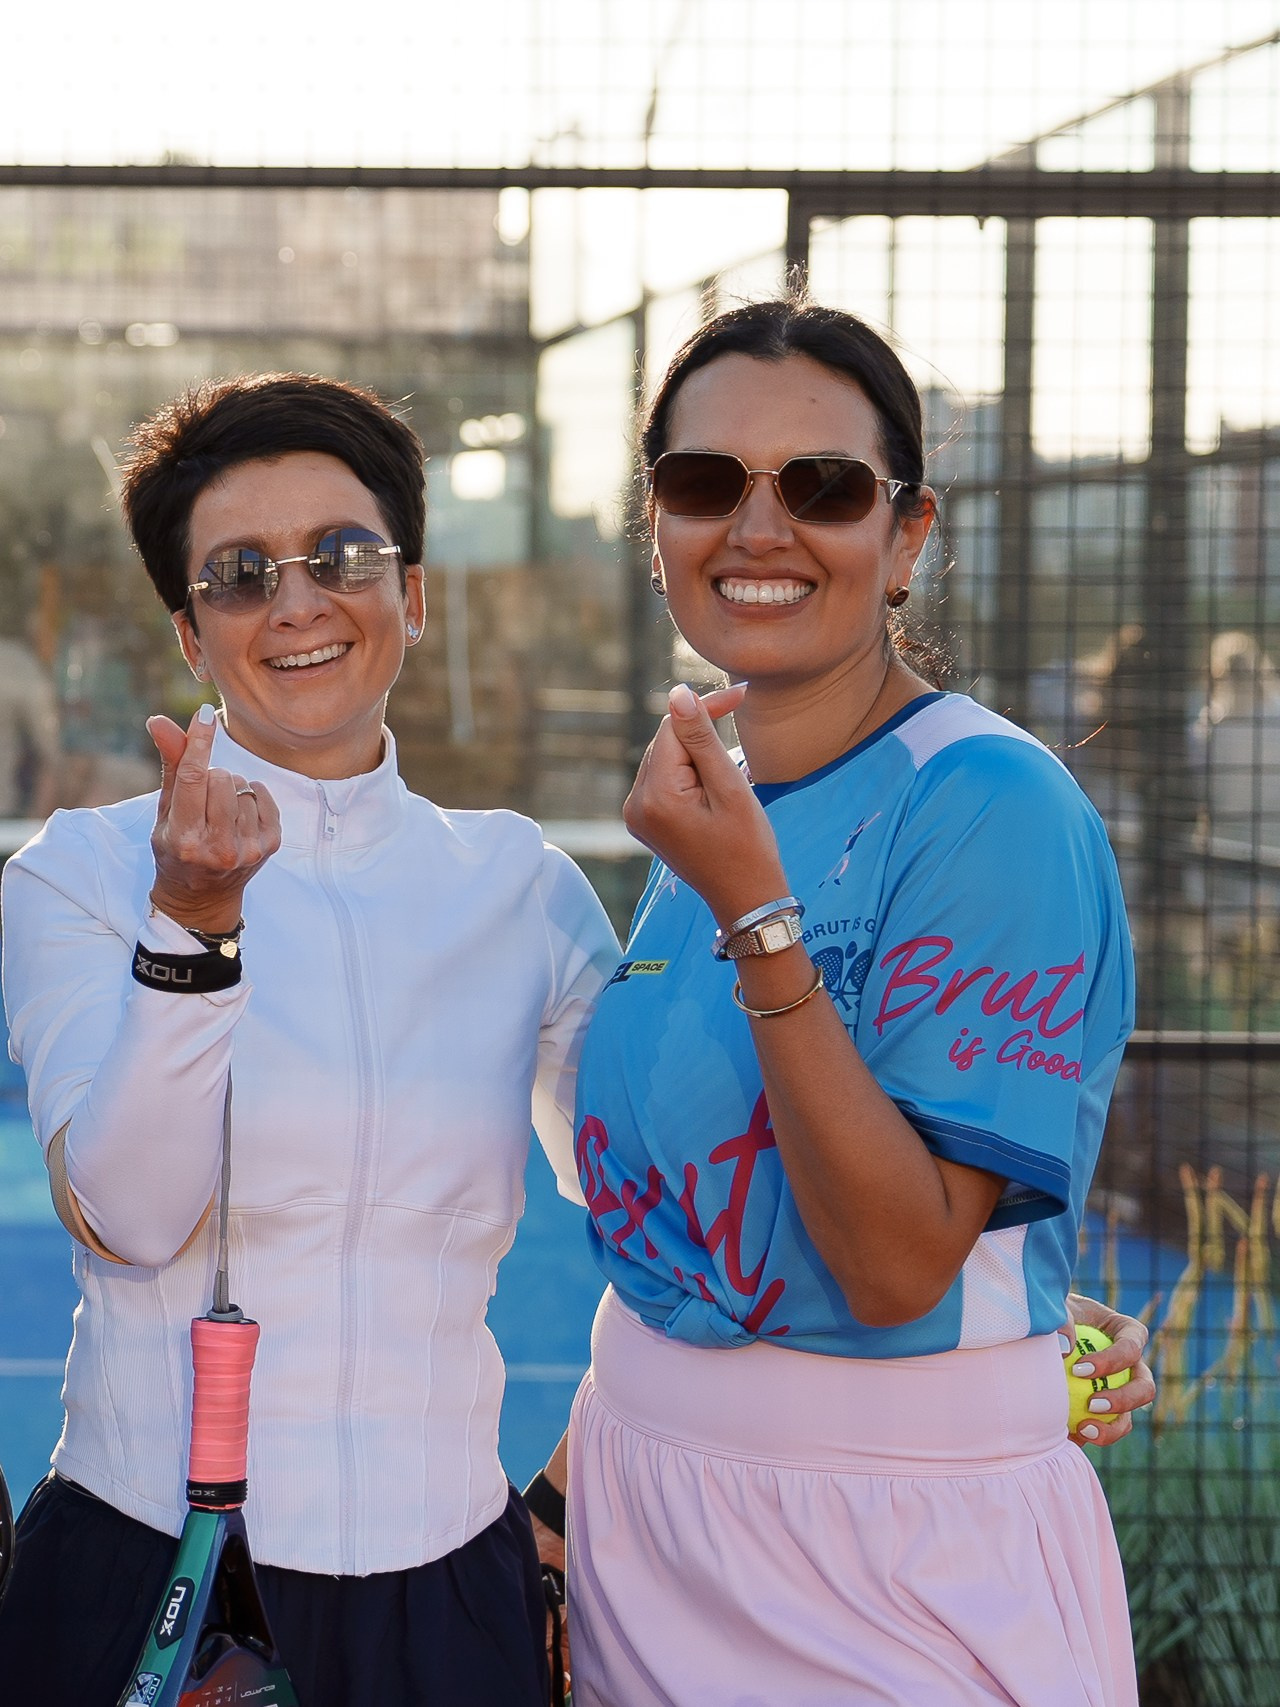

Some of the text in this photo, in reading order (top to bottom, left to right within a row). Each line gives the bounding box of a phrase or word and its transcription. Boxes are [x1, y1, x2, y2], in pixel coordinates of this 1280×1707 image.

[801, 919, 850, 944] BRUT
[631, 962, 666, 972] SPACE
[872, 935, 1085, 1039] Brut
[948, 1027, 987, 1071] is
